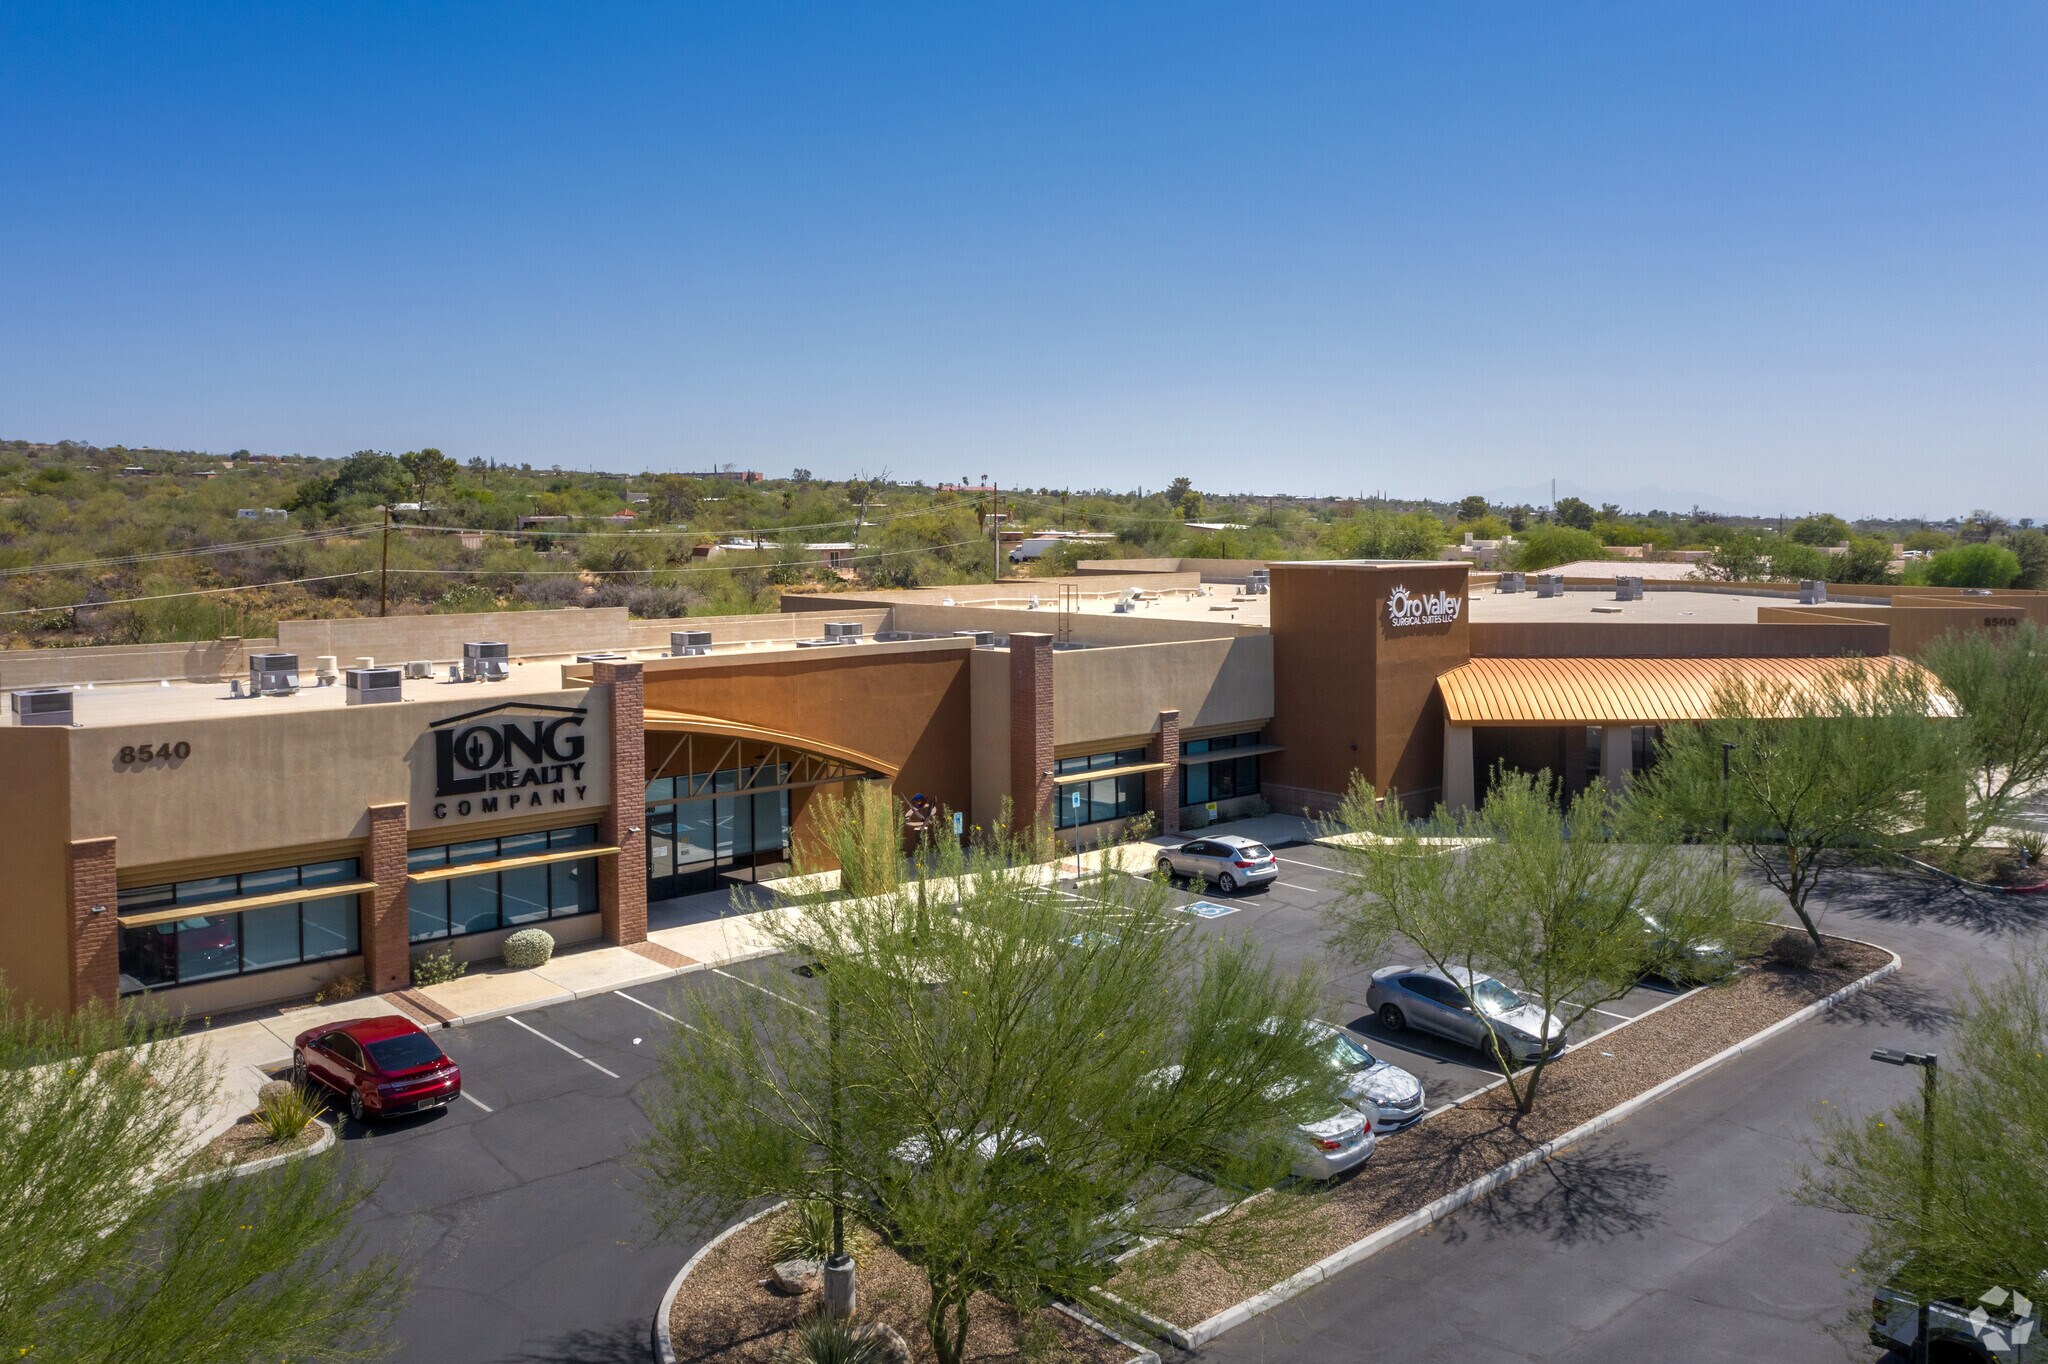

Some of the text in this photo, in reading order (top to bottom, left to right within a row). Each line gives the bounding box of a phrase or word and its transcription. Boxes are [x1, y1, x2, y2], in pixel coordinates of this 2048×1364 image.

[1391, 591, 1462, 619] Oro Valley
[1392, 614, 1453, 627] SURGICAL SUITES LLC
[1983, 617, 2016, 627] 8500
[120, 741, 191, 764] 8540
[434, 717, 585, 798] LONG
[488, 762, 585, 791] REALTY
[434, 785, 587, 819] COMPANY
